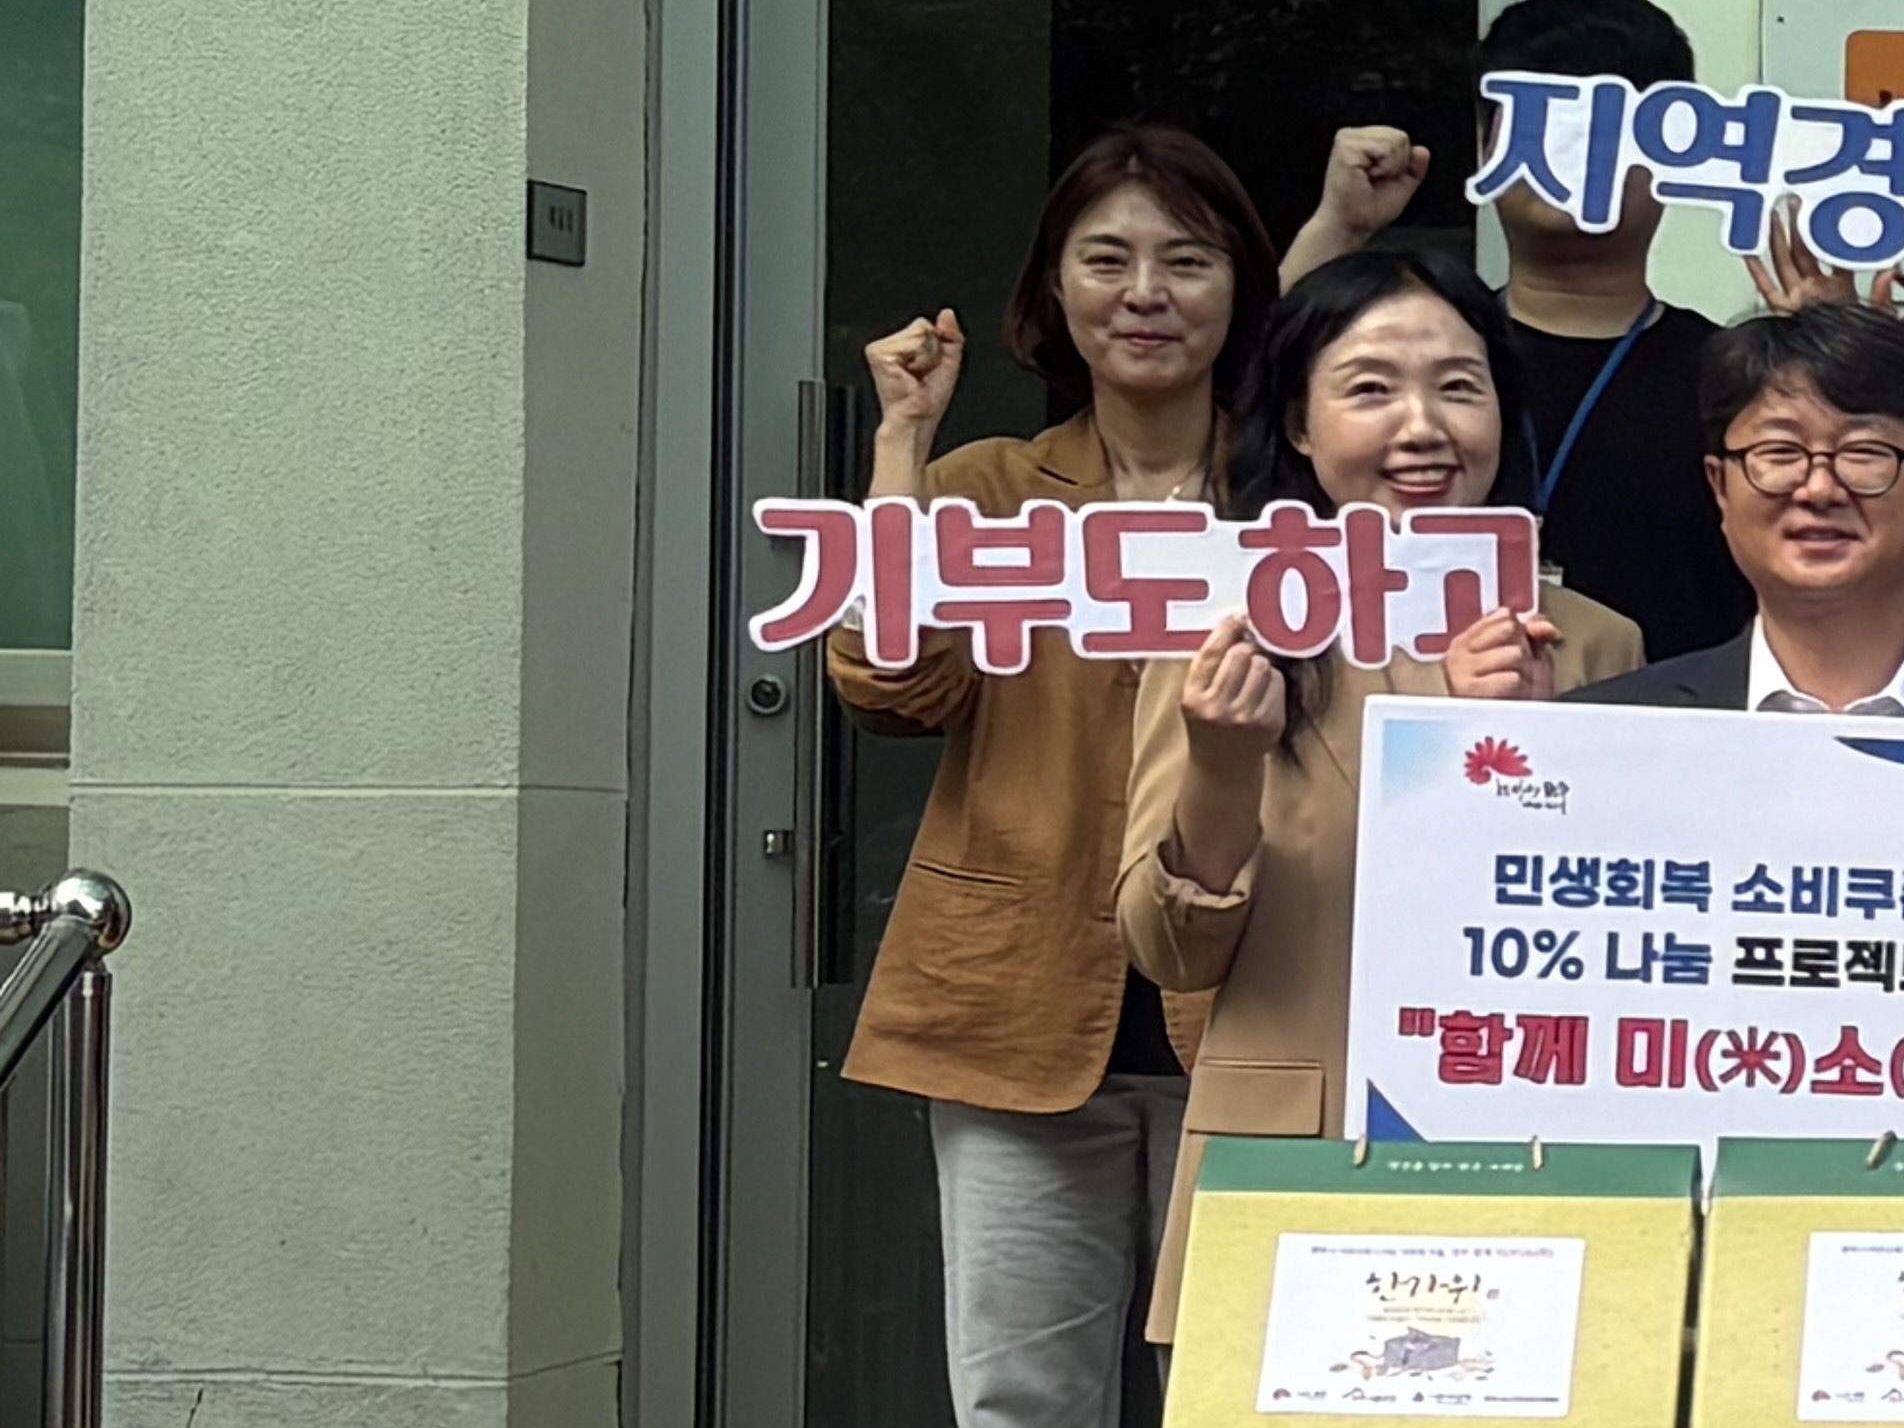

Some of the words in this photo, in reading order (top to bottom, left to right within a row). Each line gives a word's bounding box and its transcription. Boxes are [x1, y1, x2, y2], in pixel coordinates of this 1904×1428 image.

[758, 501, 1535, 669] 기부도하고
[1494, 853, 1713, 911] 민생회복
[1463, 925, 1585, 981] 10%
[1605, 930, 1713, 985] 나눔
[1398, 1007, 1590, 1086] "함께
[1365, 1271, 1481, 1303] 한가위
